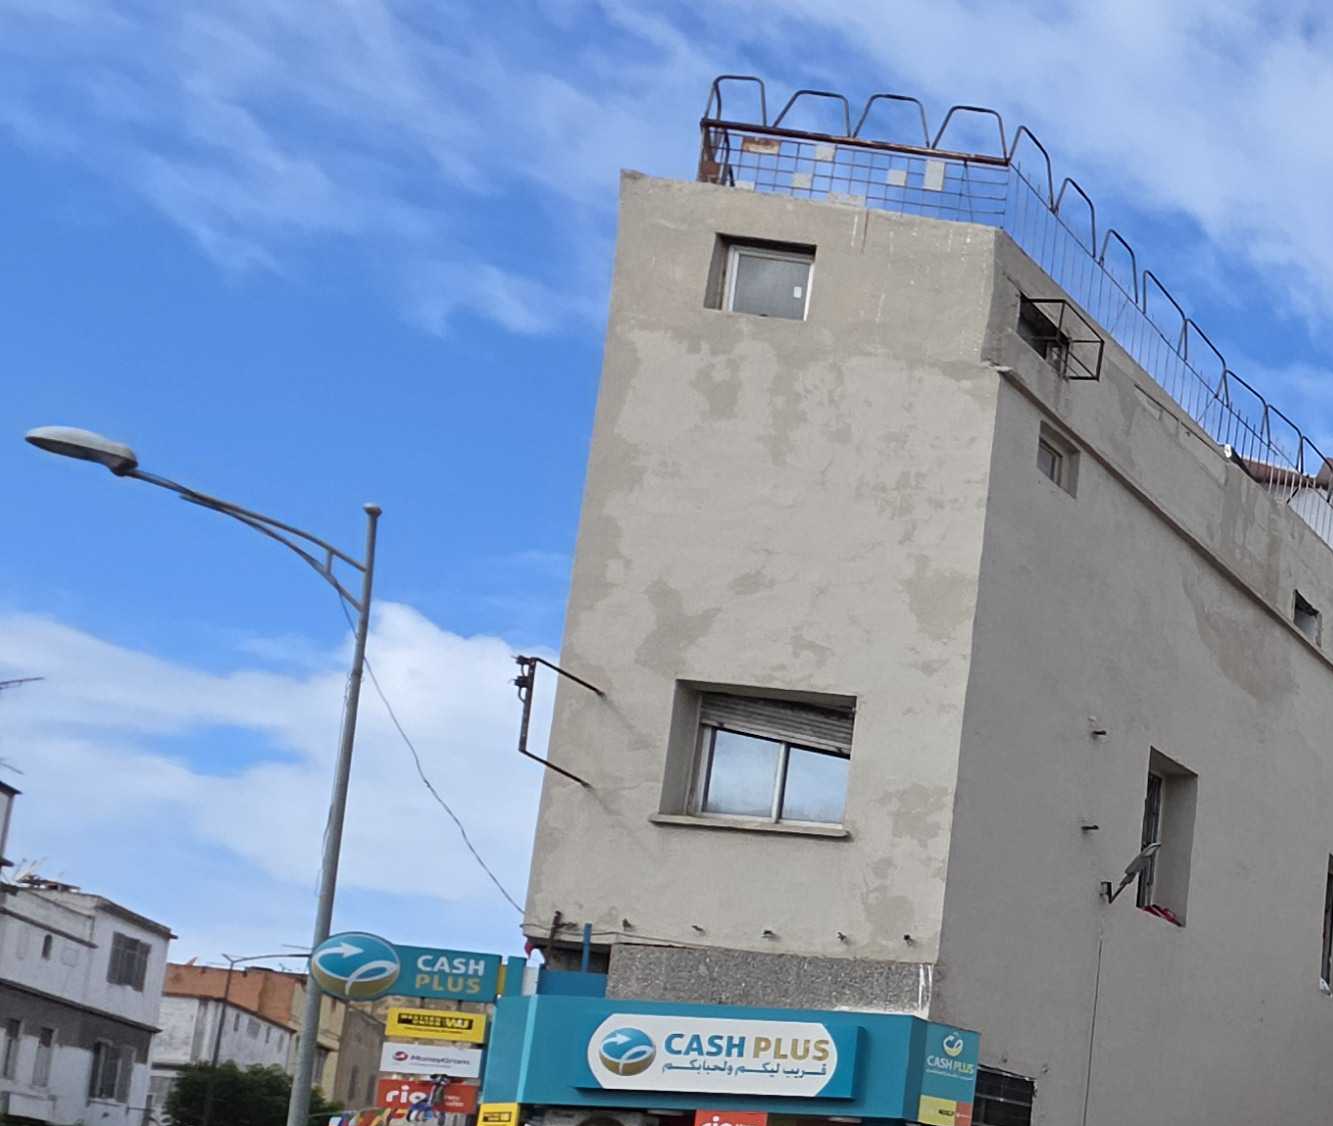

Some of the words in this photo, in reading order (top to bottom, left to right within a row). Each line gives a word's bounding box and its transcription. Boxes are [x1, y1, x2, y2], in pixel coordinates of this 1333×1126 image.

[417, 954, 486, 976] CASH
[415, 974, 481, 994] PLUS
[664, 1033, 746, 1058] CASH
[752, 1036, 831, 1061] PLUS
[735, 1062, 781, 1077] ليكم
[782, 1063, 827, 1079] قريب
[926, 1055, 953, 1071] CASH
[953, 1060, 975, 1074] PLUS
